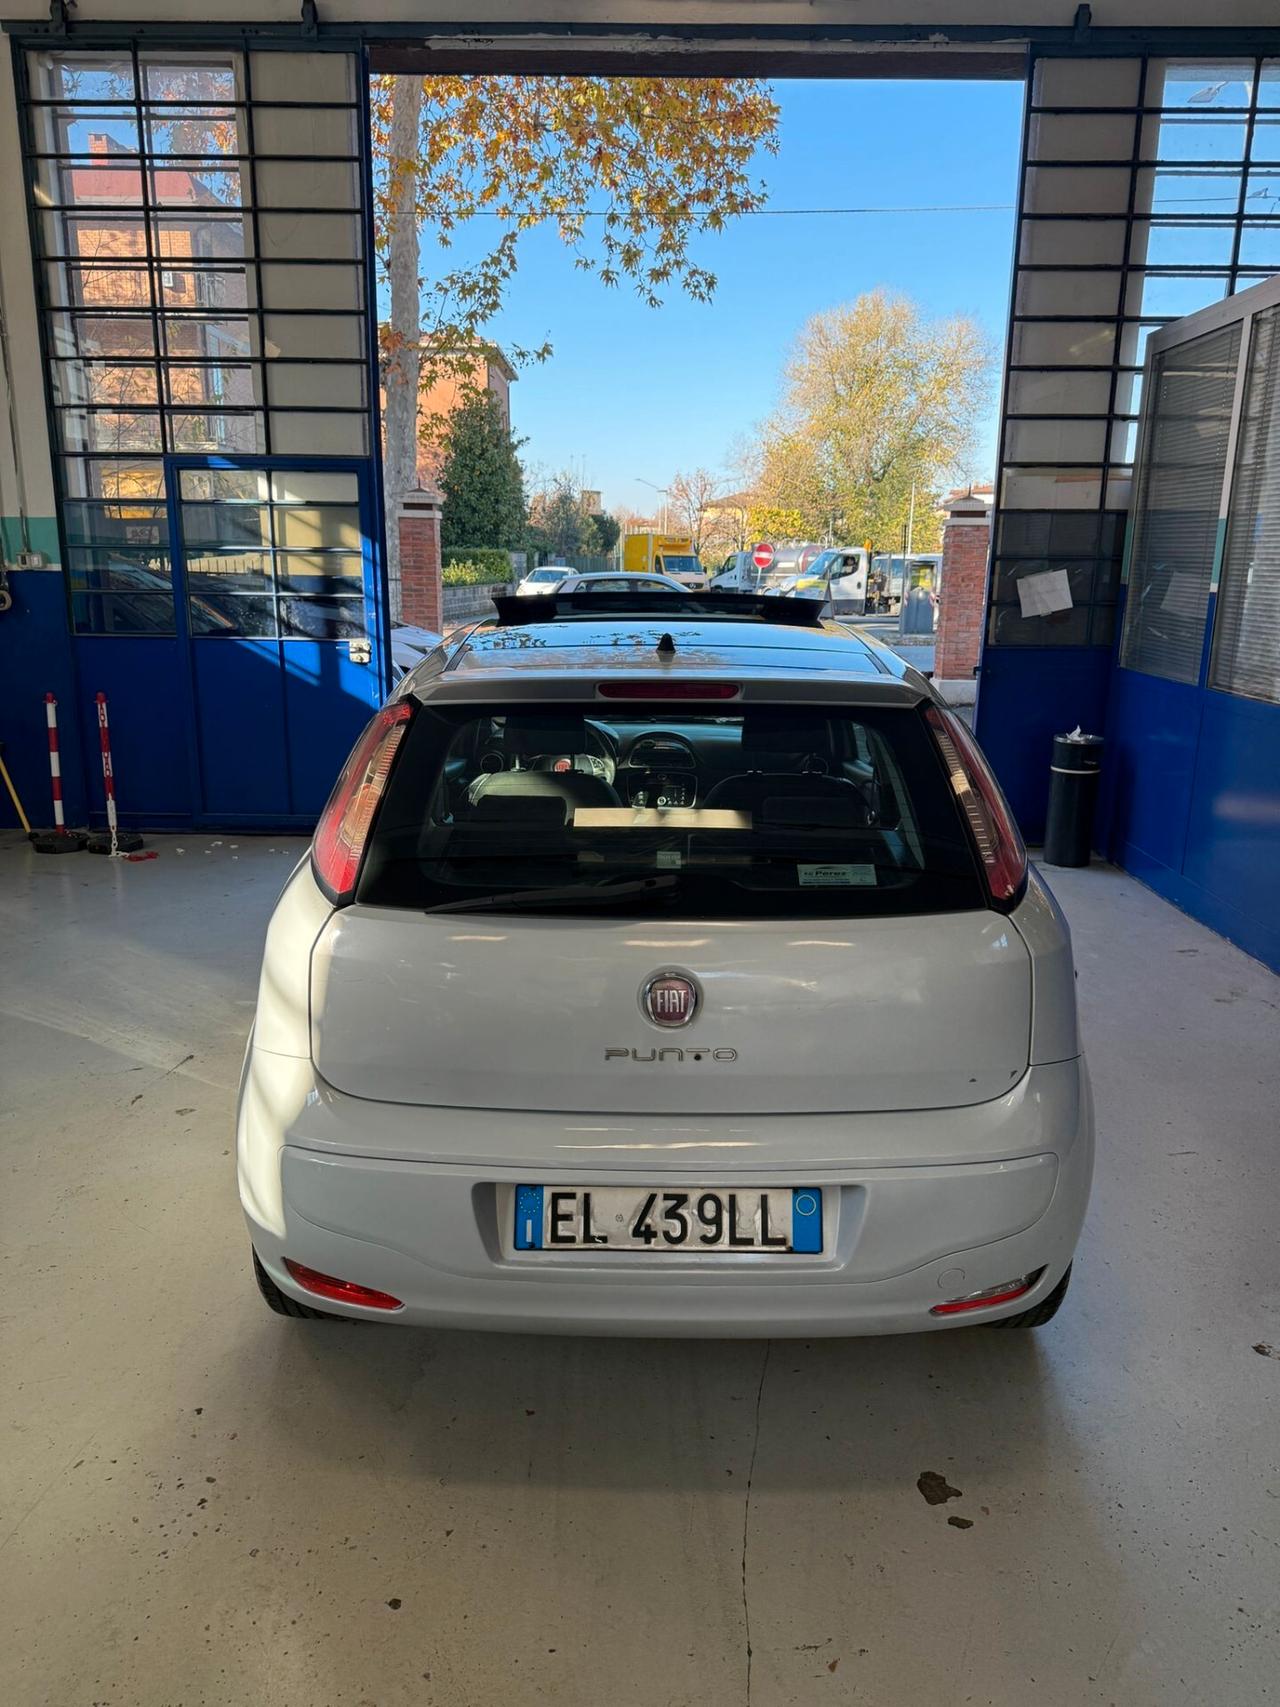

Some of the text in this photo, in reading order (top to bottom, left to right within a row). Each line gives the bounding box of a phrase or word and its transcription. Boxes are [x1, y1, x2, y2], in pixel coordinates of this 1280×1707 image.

[656, 989, 688, 1013] FIAT
[604, 1047, 738, 1062] PUNTO
[551, 1192, 608, 1244] EL
[632, 1192, 787, 1246] 439LL
